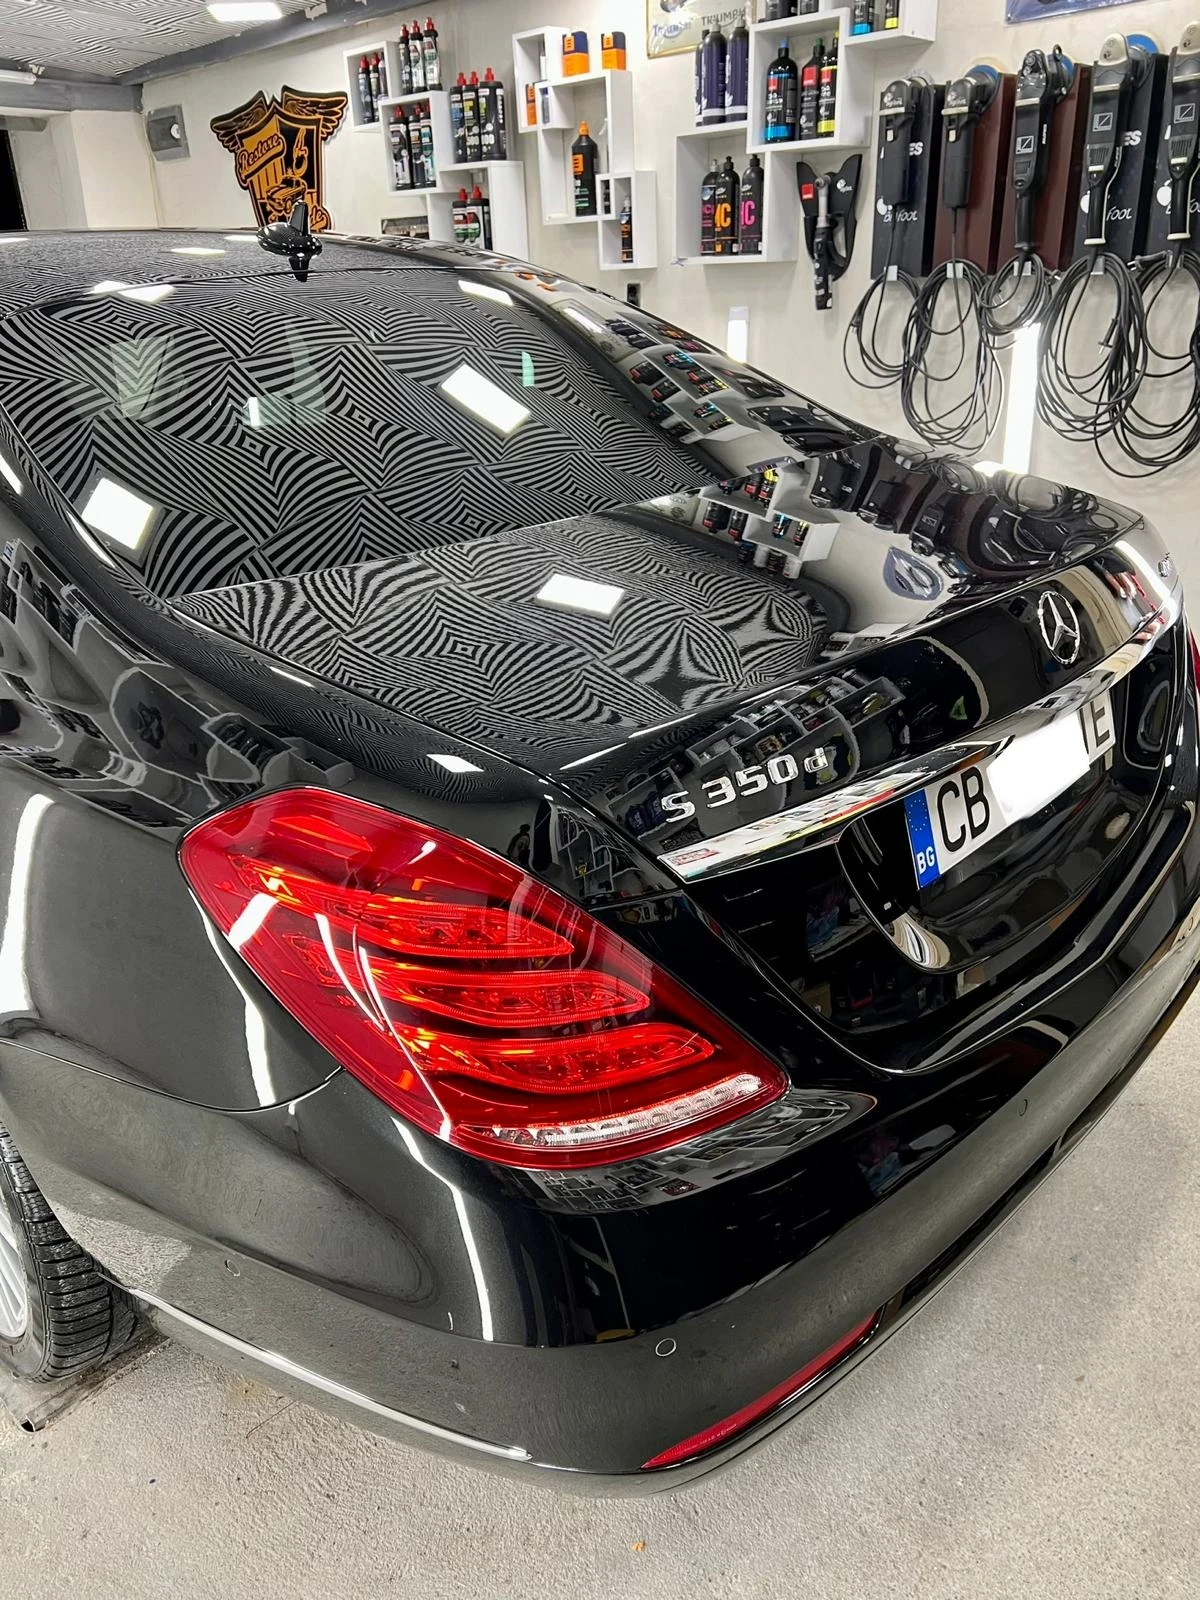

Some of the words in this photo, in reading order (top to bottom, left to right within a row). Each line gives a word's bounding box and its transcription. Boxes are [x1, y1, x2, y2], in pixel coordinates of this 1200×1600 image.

[239, 134, 280, 172] Restore
[661, 791, 696, 823] S
[701, 754, 798, 809] 350
[803, 747, 829, 774] d
[937, 766, 990, 853] CB
[916, 845, 936, 876] BG
